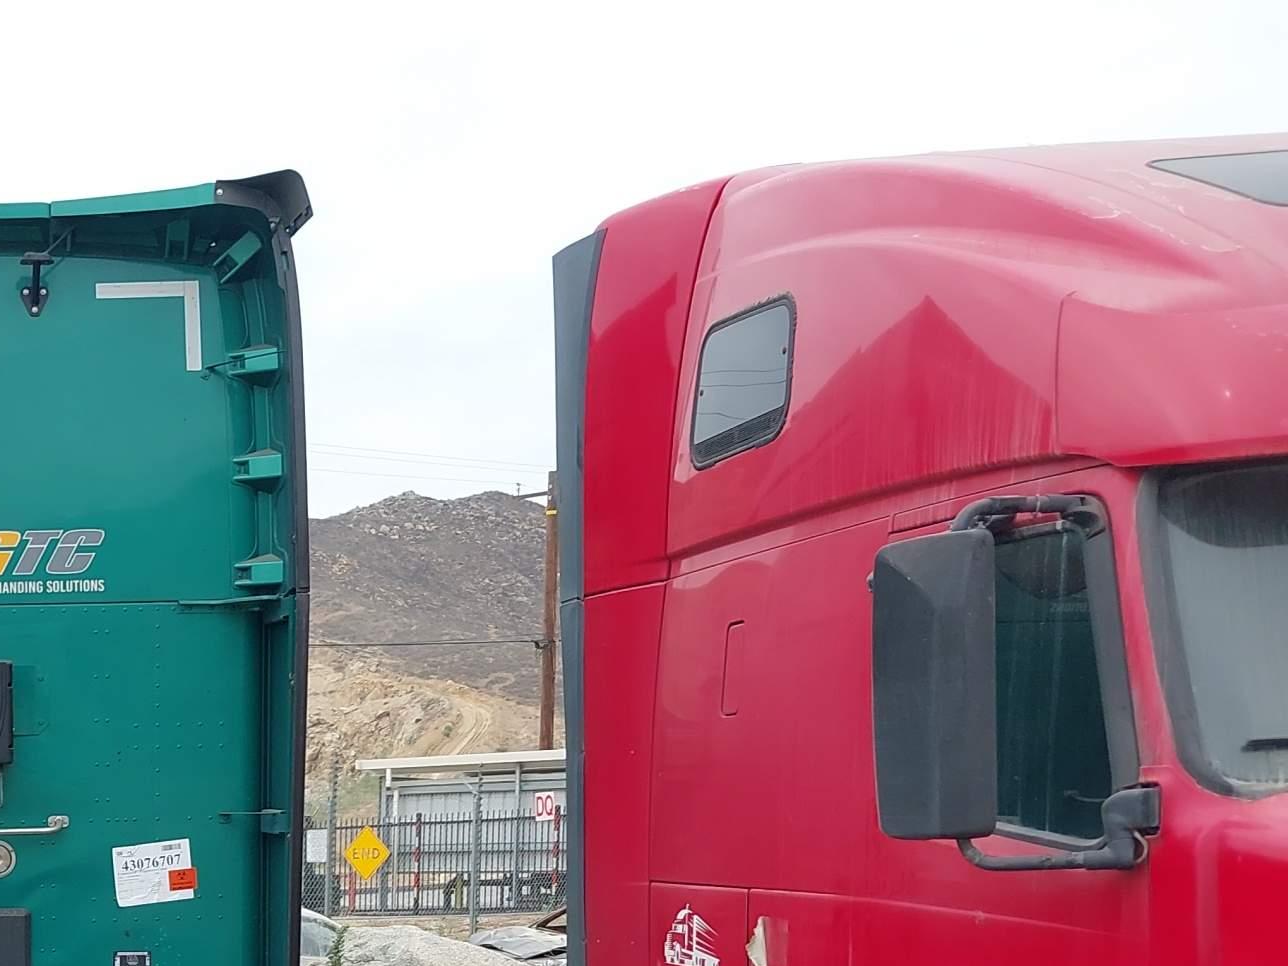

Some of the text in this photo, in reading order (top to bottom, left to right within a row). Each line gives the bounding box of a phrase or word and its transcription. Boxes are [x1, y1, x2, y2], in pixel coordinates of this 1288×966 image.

[46, 579, 105, 594] SOLUTIONS
[352, 847, 381, 860] END
[121, 853, 182, 872] 43076707
